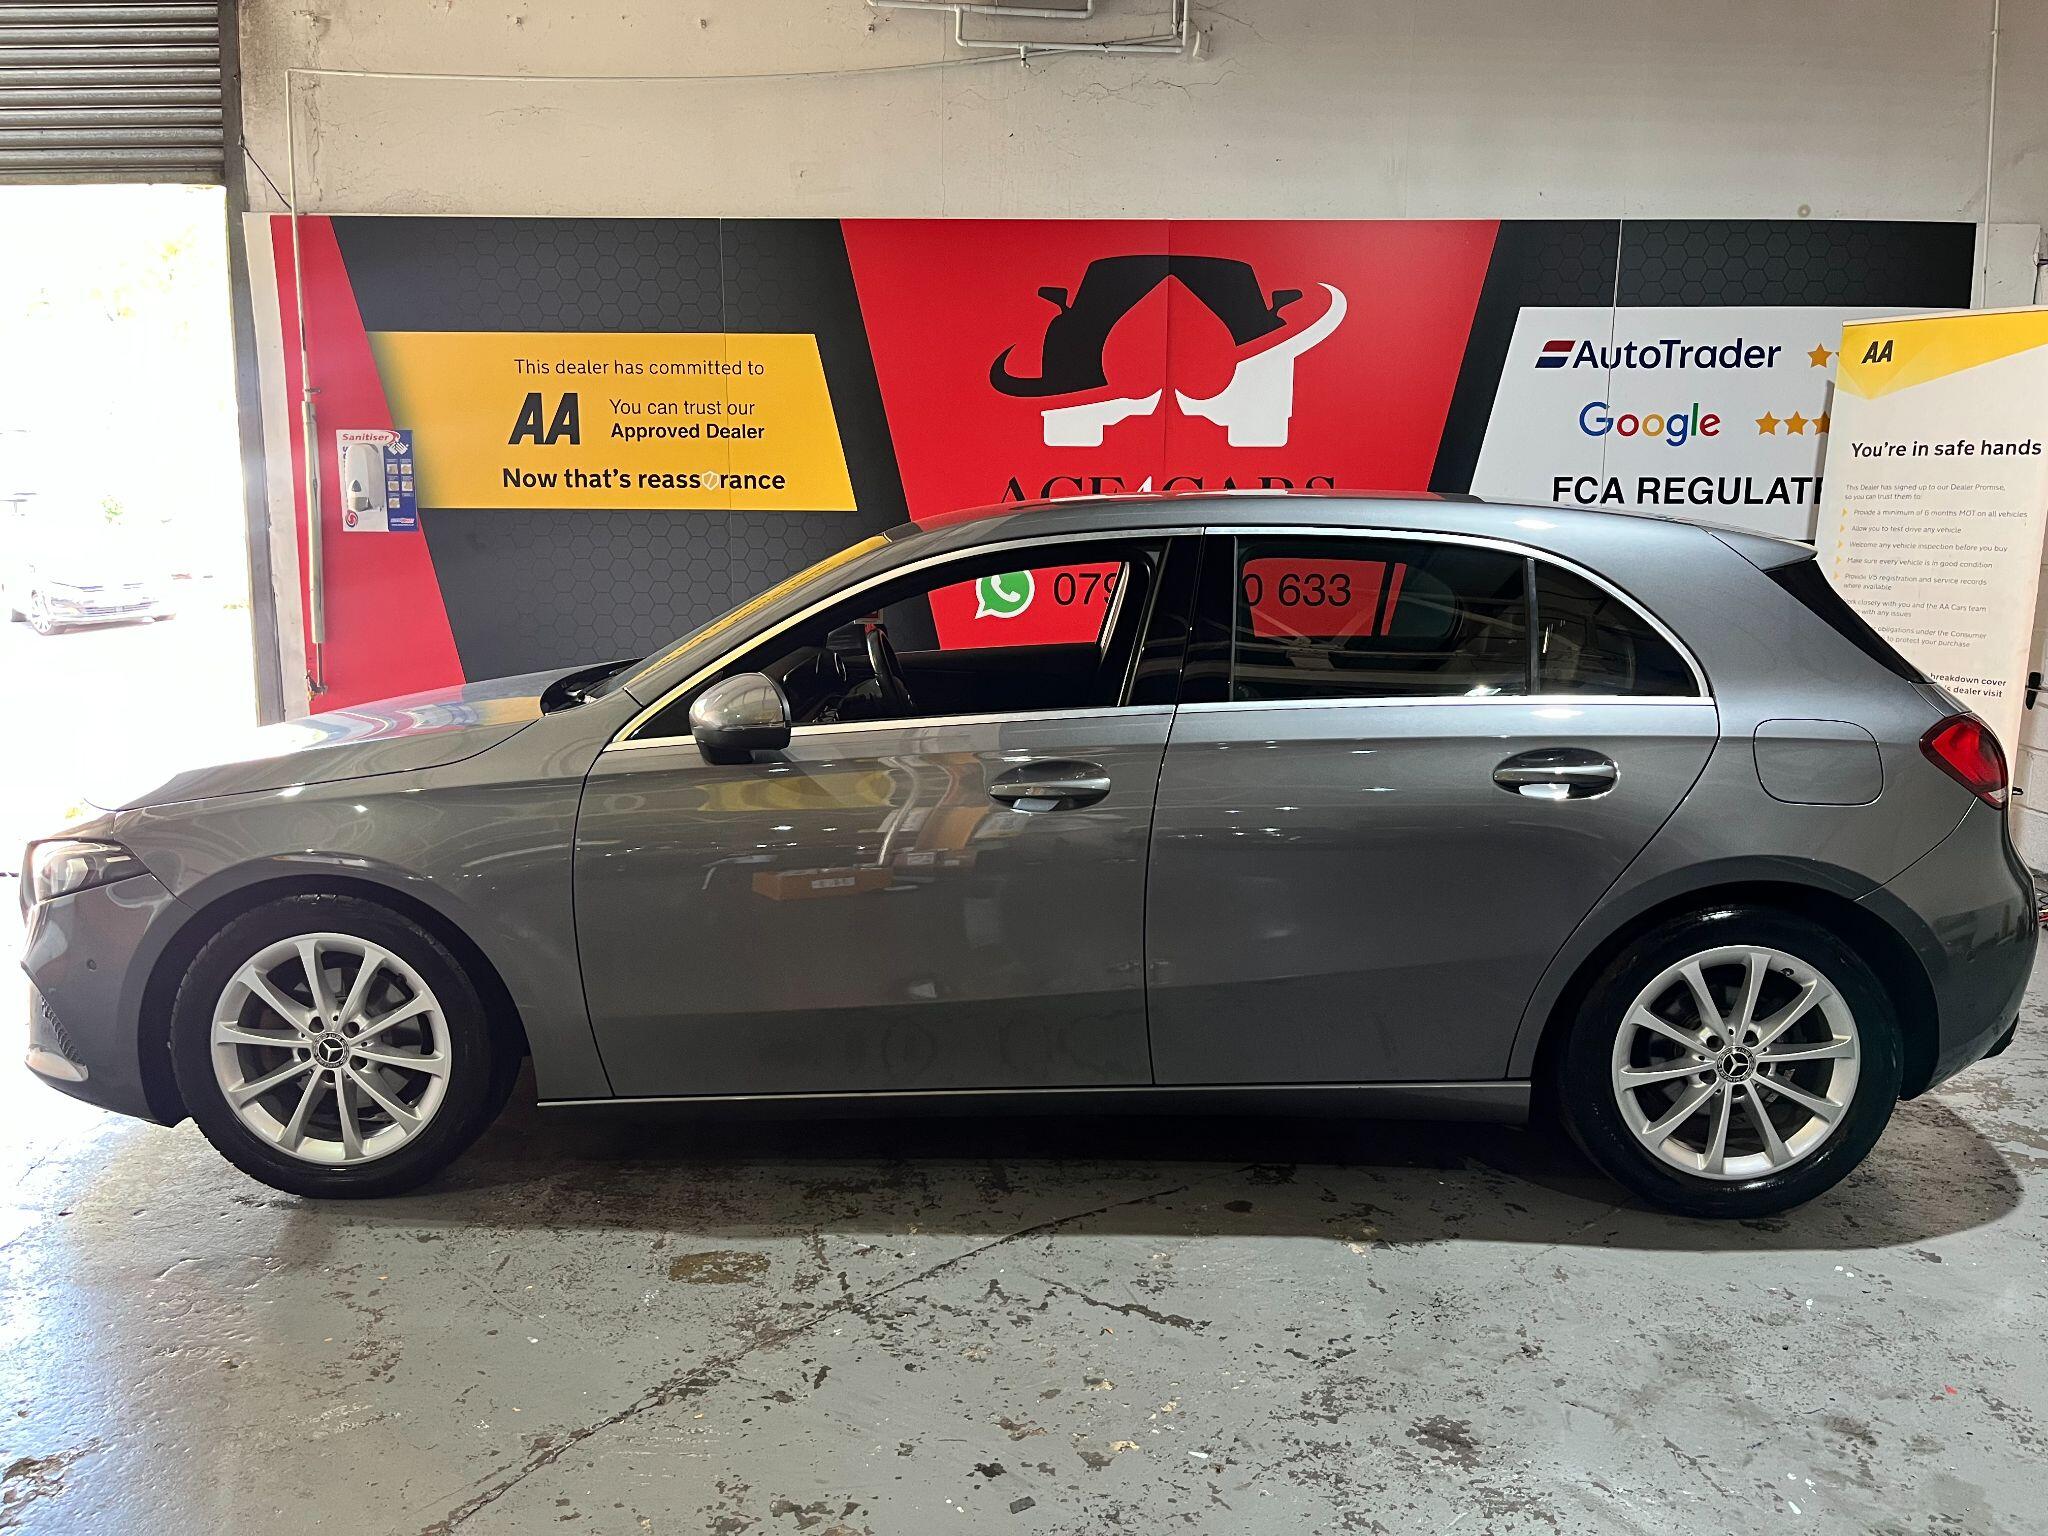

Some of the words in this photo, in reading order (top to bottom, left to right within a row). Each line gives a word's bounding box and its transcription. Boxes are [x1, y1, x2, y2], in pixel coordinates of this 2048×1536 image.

[1572, 338, 1782, 370] AutoTrader
[1861, 340, 1894, 364] AA
[514, 359, 550, 375] This
[555, 360, 609, 375] dealer
[614, 360, 644, 375] has
[649, 360, 740, 376] committed
[748, 361, 765, 376] to
[609, 399, 642, 415] You
[647, 402, 678, 415] can
[684, 400, 721, 415] trust
[728, 402, 755, 416] our
[508, 392, 581, 445] AA
[1579, 401, 1721, 447] Google
[342, 433, 390, 441] Sanitiser
[611, 423, 700, 442] Approved
[706, 423, 765, 440] Dealer
[1851, 441, 1907, 458] You're
[1912, 440, 1929, 457] in
[1934, 439, 1975, 457] safe
[1981, 438, 2042, 456] hands
[503, 468, 558, 488] Now
[564, 468, 631, 488] that's
[1894, 484, 1917, 492] signed
[1951, 483, 1973, 491] Dealer
[1552, 476, 1629, 504] FCA
[1637, 476, 1822, 505] REGULAT
[1278, 573, 1351, 607] 633
[1953, 685, 1981, 696] dealer
[1983, 689, 2003, 698] visit
[1981, 677, 2007, 687] cover
